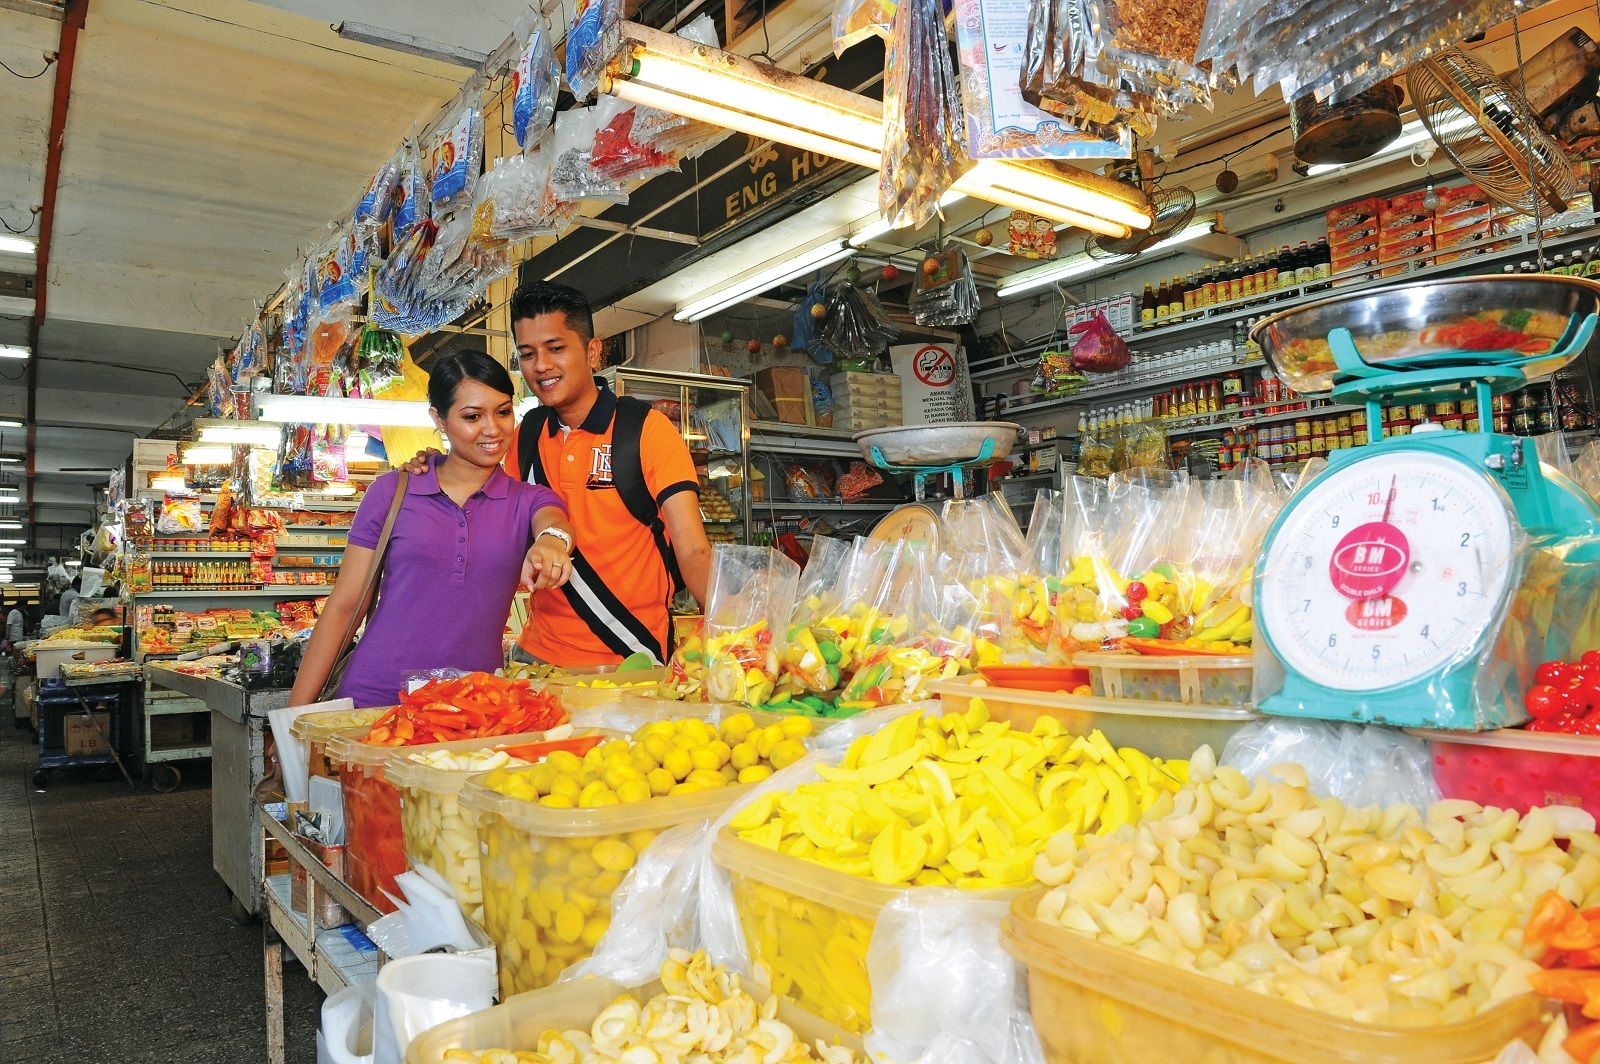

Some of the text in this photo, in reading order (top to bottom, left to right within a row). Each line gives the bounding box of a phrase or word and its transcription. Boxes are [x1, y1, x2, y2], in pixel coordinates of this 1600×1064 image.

[725, 172, 777, 218] ENG
[1332, 516, 1340, 528] 9
[1461, 533, 1471, 547] 2
[1353, 546, 1386, 564] BM
[1305, 555, 1313, 570] 8
[1340, 583, 1363, 597] DOUBLE
[1457, 582, 1467, 596] 3
[1303, 599, 1311, 612] 7
[1357, 617, 1393, 627] SERIES
[1420, 623, 1430, 638] 4
[1328, 634, 1337, 648] 6
[1371, 644, 1381, 659] 5
[80, 740, 97, 748] LB
